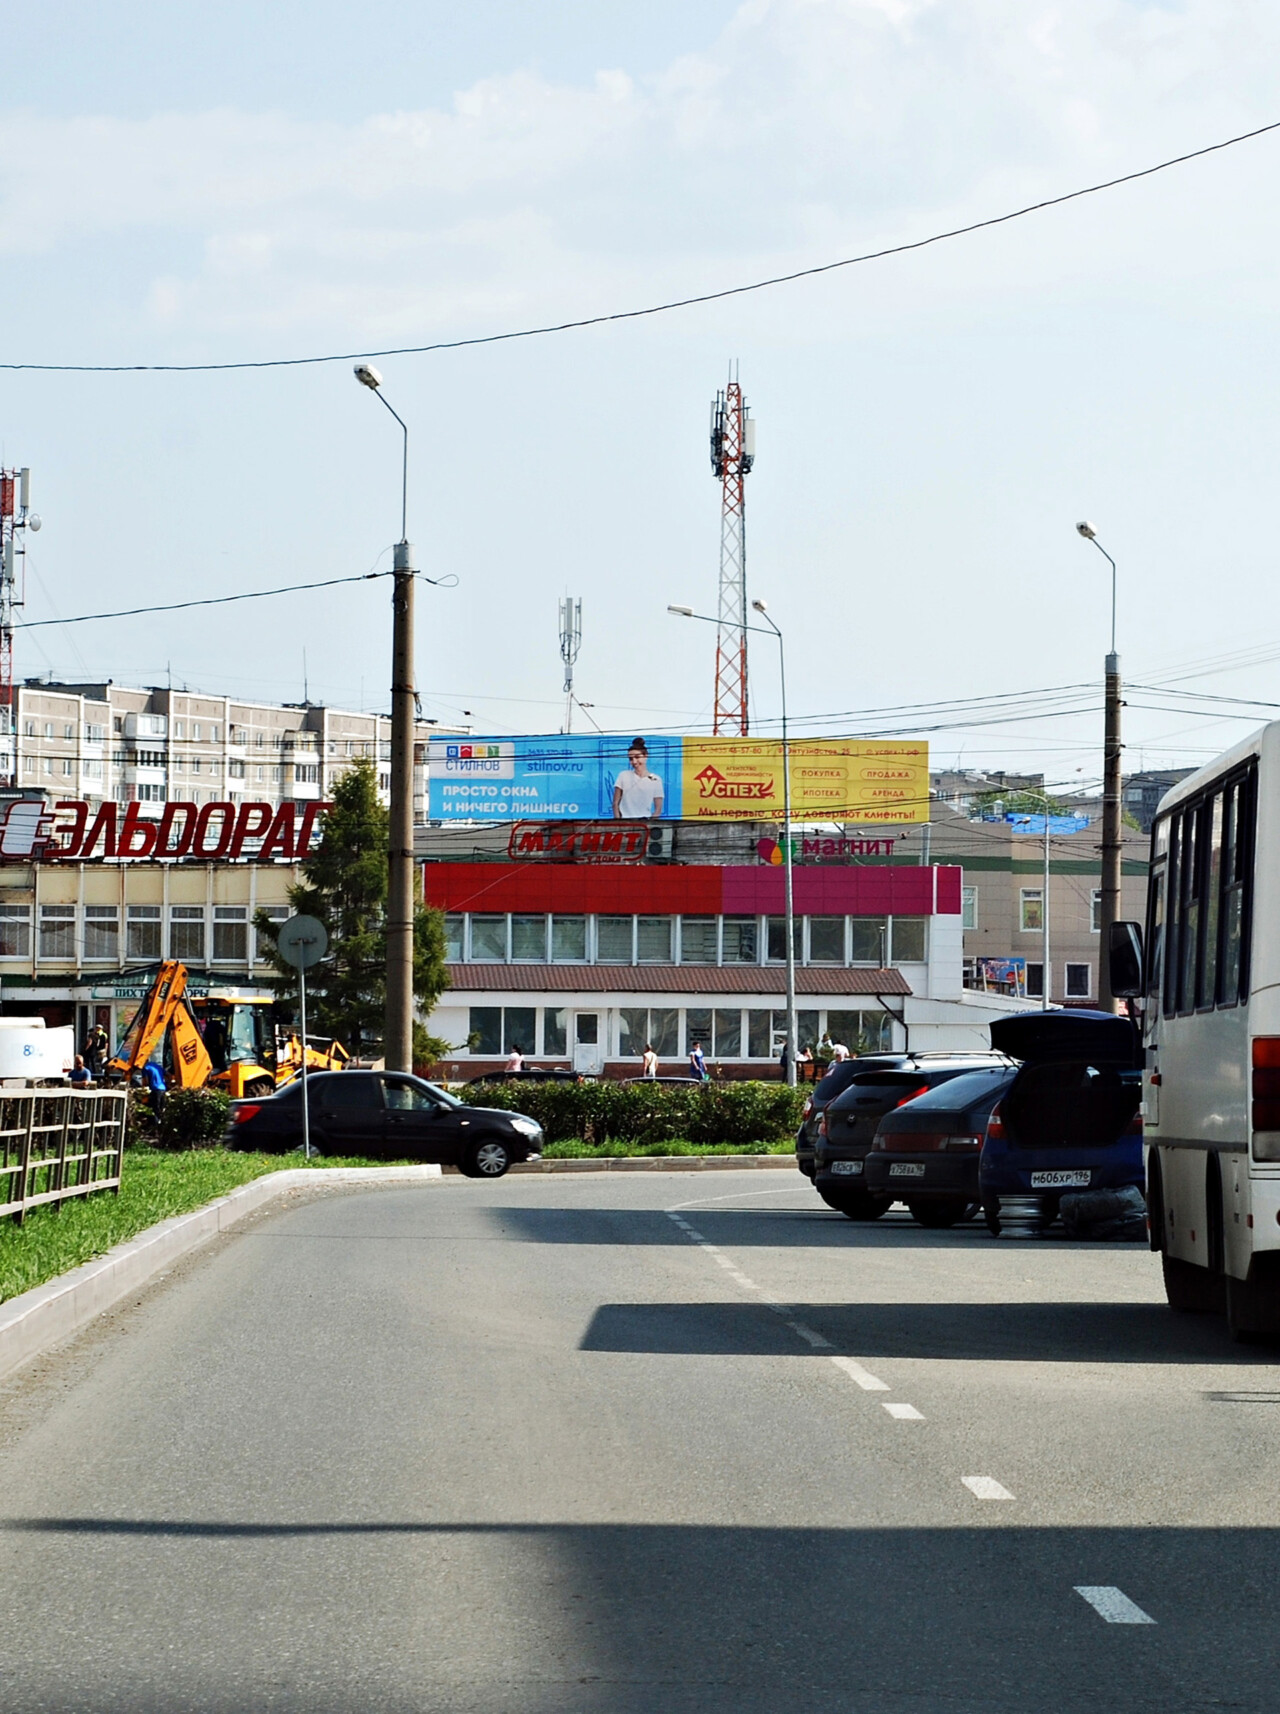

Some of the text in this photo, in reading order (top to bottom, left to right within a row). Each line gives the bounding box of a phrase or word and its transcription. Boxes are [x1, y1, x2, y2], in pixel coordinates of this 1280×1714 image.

[445, 759, 500, 771] СТИЛНОВ
[527, 758, 583, 771] stilnov.ru
[867, 771, 910, 779] ПРОДАЖА
[442, 785, 539, 797] ПРОСТО ОКНА
[803, 789, 841, 797] ИПОТЕКА
[442, 802, 579, 814] И НИЧЕГО ЛИШНЕГО
[698, 807, 718, 818] Мы
[803, 809, 861, 820] доверяют
[864, 810, 916, 820] клиенты!
[517, 831, 642, 852] МАГНИТ
[1073, 1171, 1089, 1180] 196
